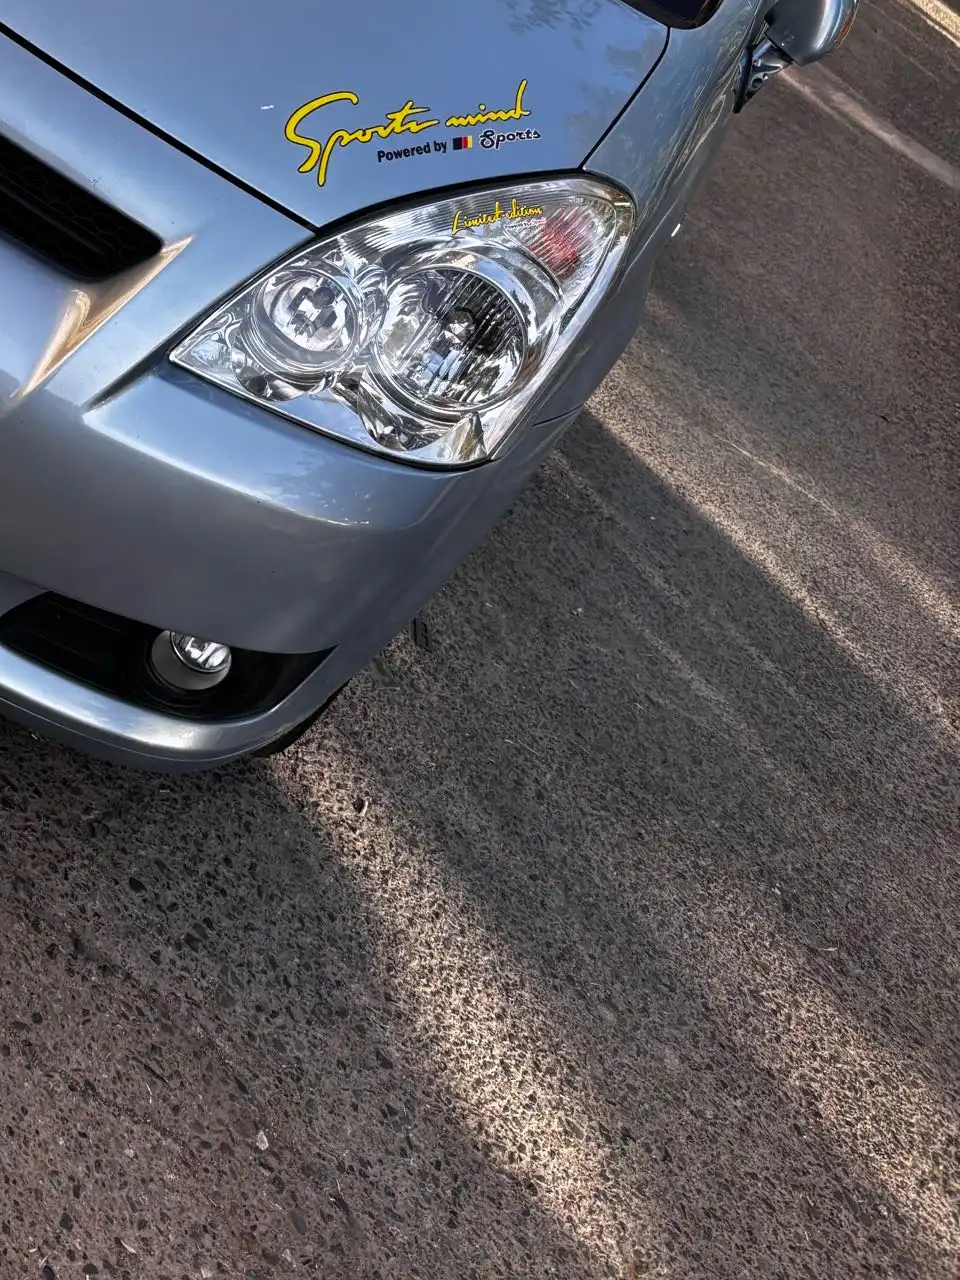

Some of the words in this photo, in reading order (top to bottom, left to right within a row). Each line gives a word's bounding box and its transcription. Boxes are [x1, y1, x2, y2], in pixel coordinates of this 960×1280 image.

[285, 91, 439, 187] Sports
[445, 79, 531, 127] mind
[377, 141, 431, 163] Powered
[433, 140, 447, 153] by
[480, 129, 542, 149] Sports
